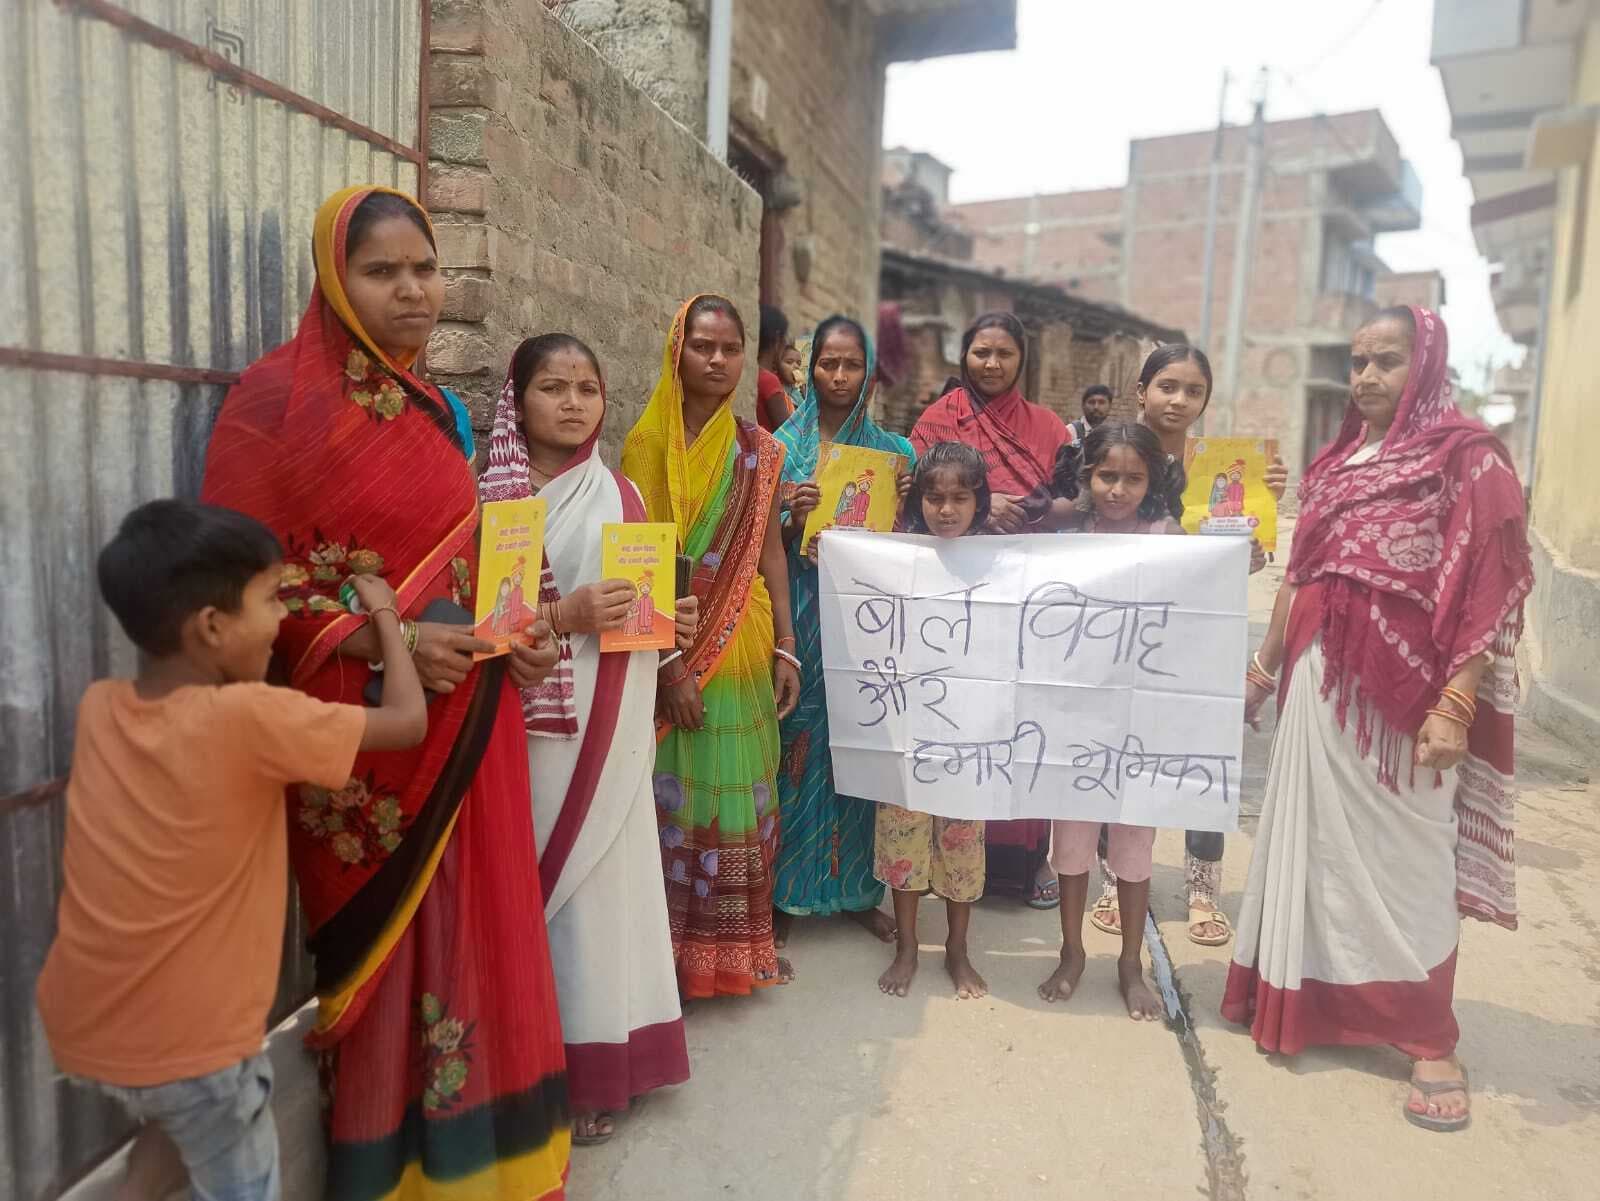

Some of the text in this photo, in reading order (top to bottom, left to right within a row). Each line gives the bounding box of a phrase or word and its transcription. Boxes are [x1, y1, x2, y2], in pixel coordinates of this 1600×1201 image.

[851, 577, 1180, 677] बाल विवाह
[855, 656, 961, 730] और
[912, 720, 1237, 803] हमारी भूमिका
